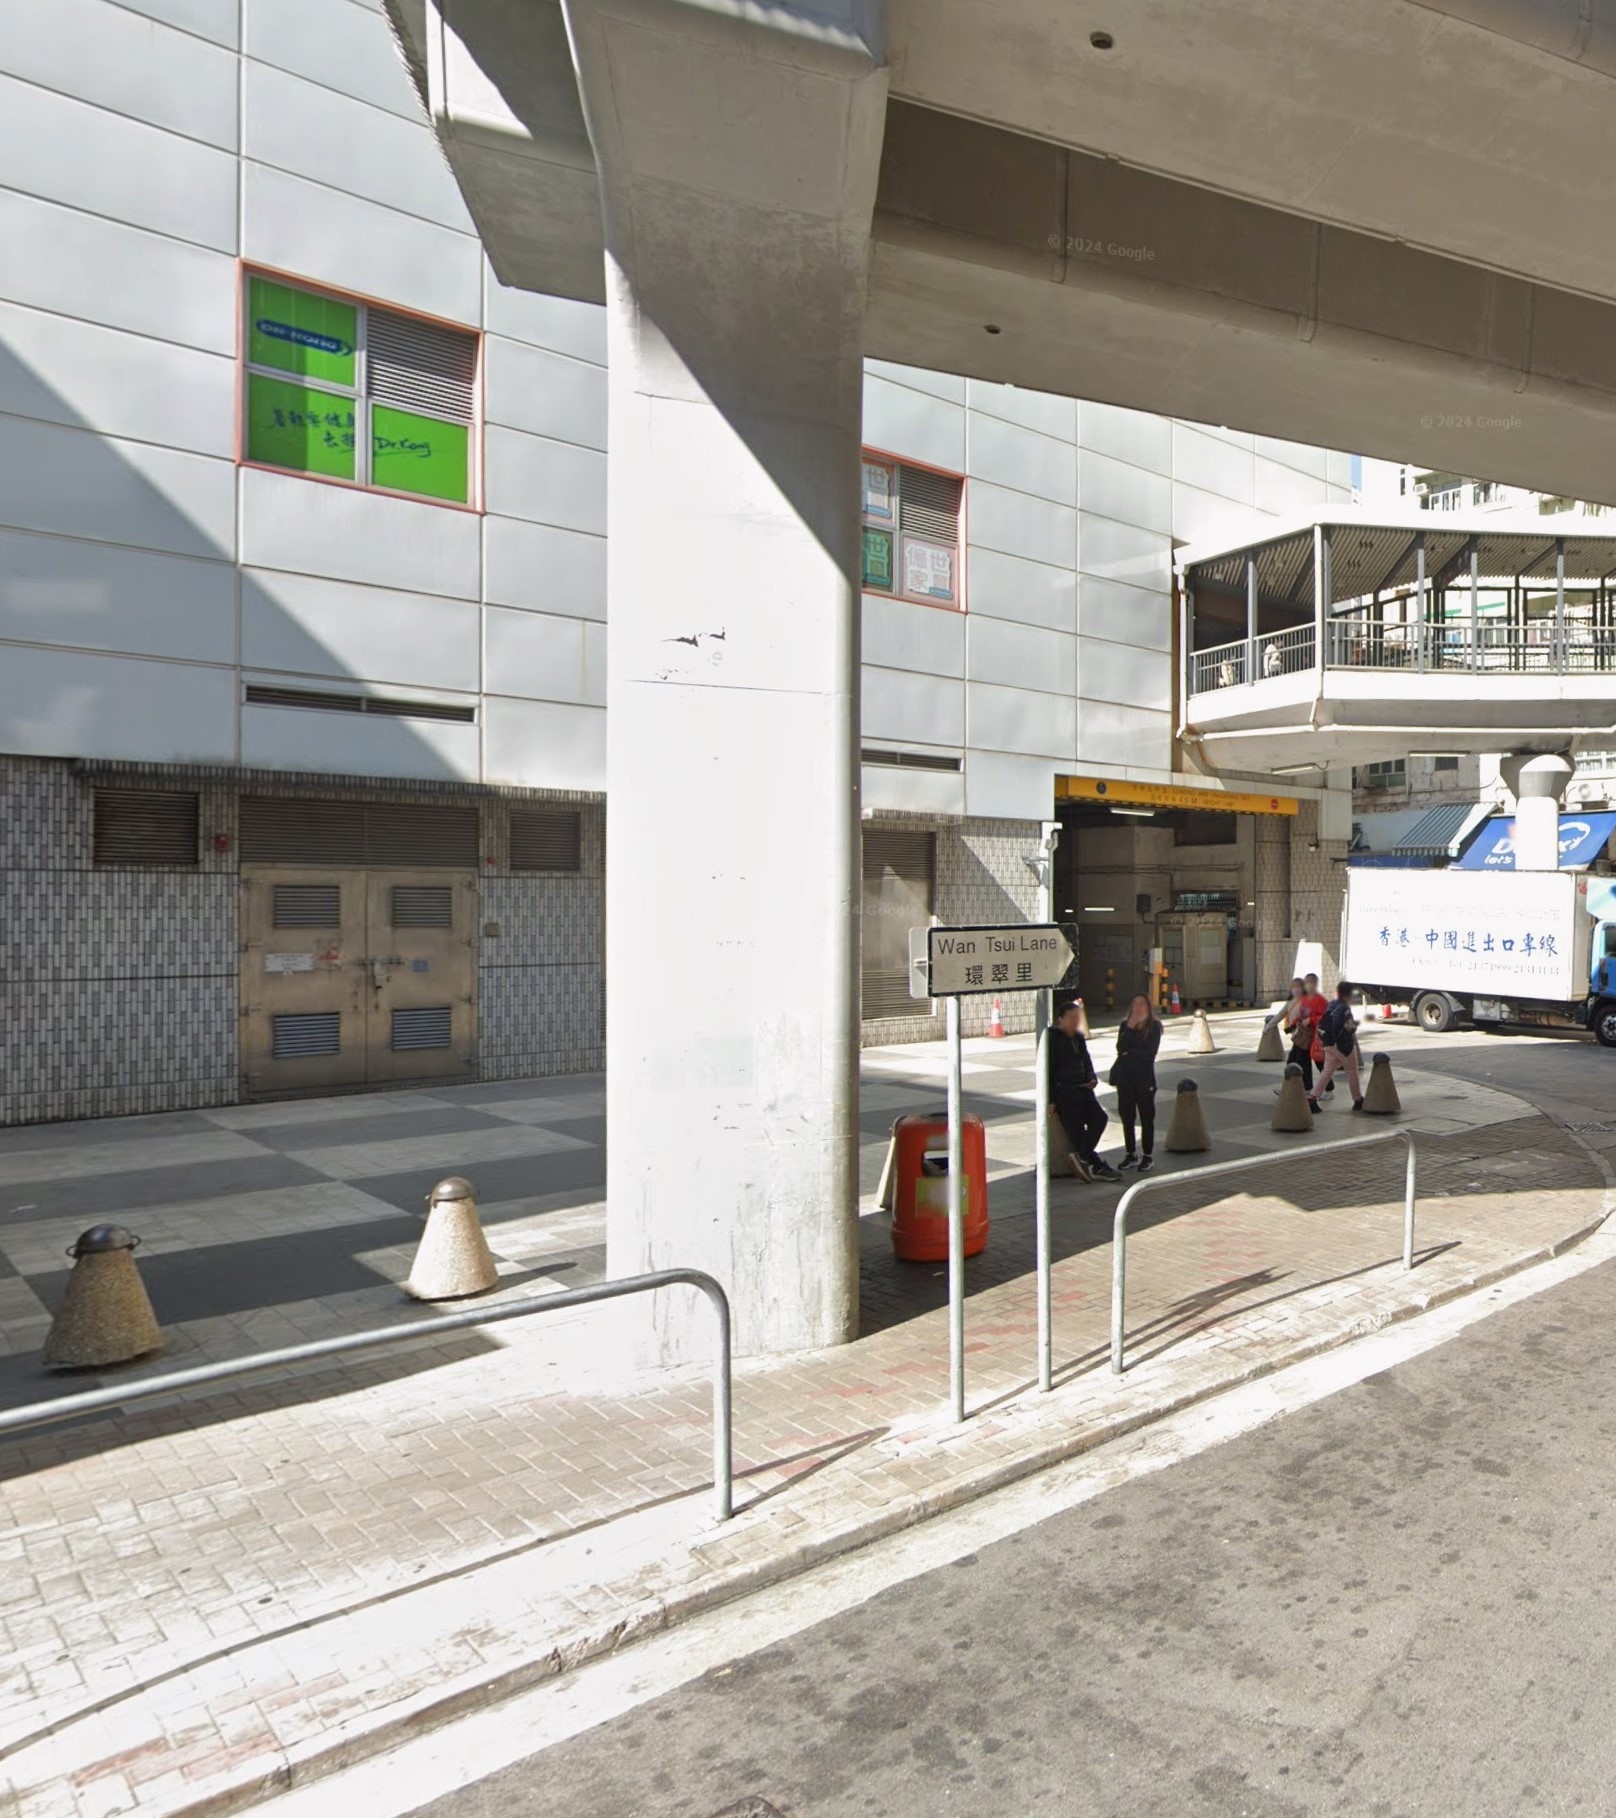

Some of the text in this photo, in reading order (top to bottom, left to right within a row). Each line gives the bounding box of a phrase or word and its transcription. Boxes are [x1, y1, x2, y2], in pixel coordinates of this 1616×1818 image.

[937, 935, 1058, 955] Wan Tsui Lane
[964, 962, 1034, 987] 環翠里
